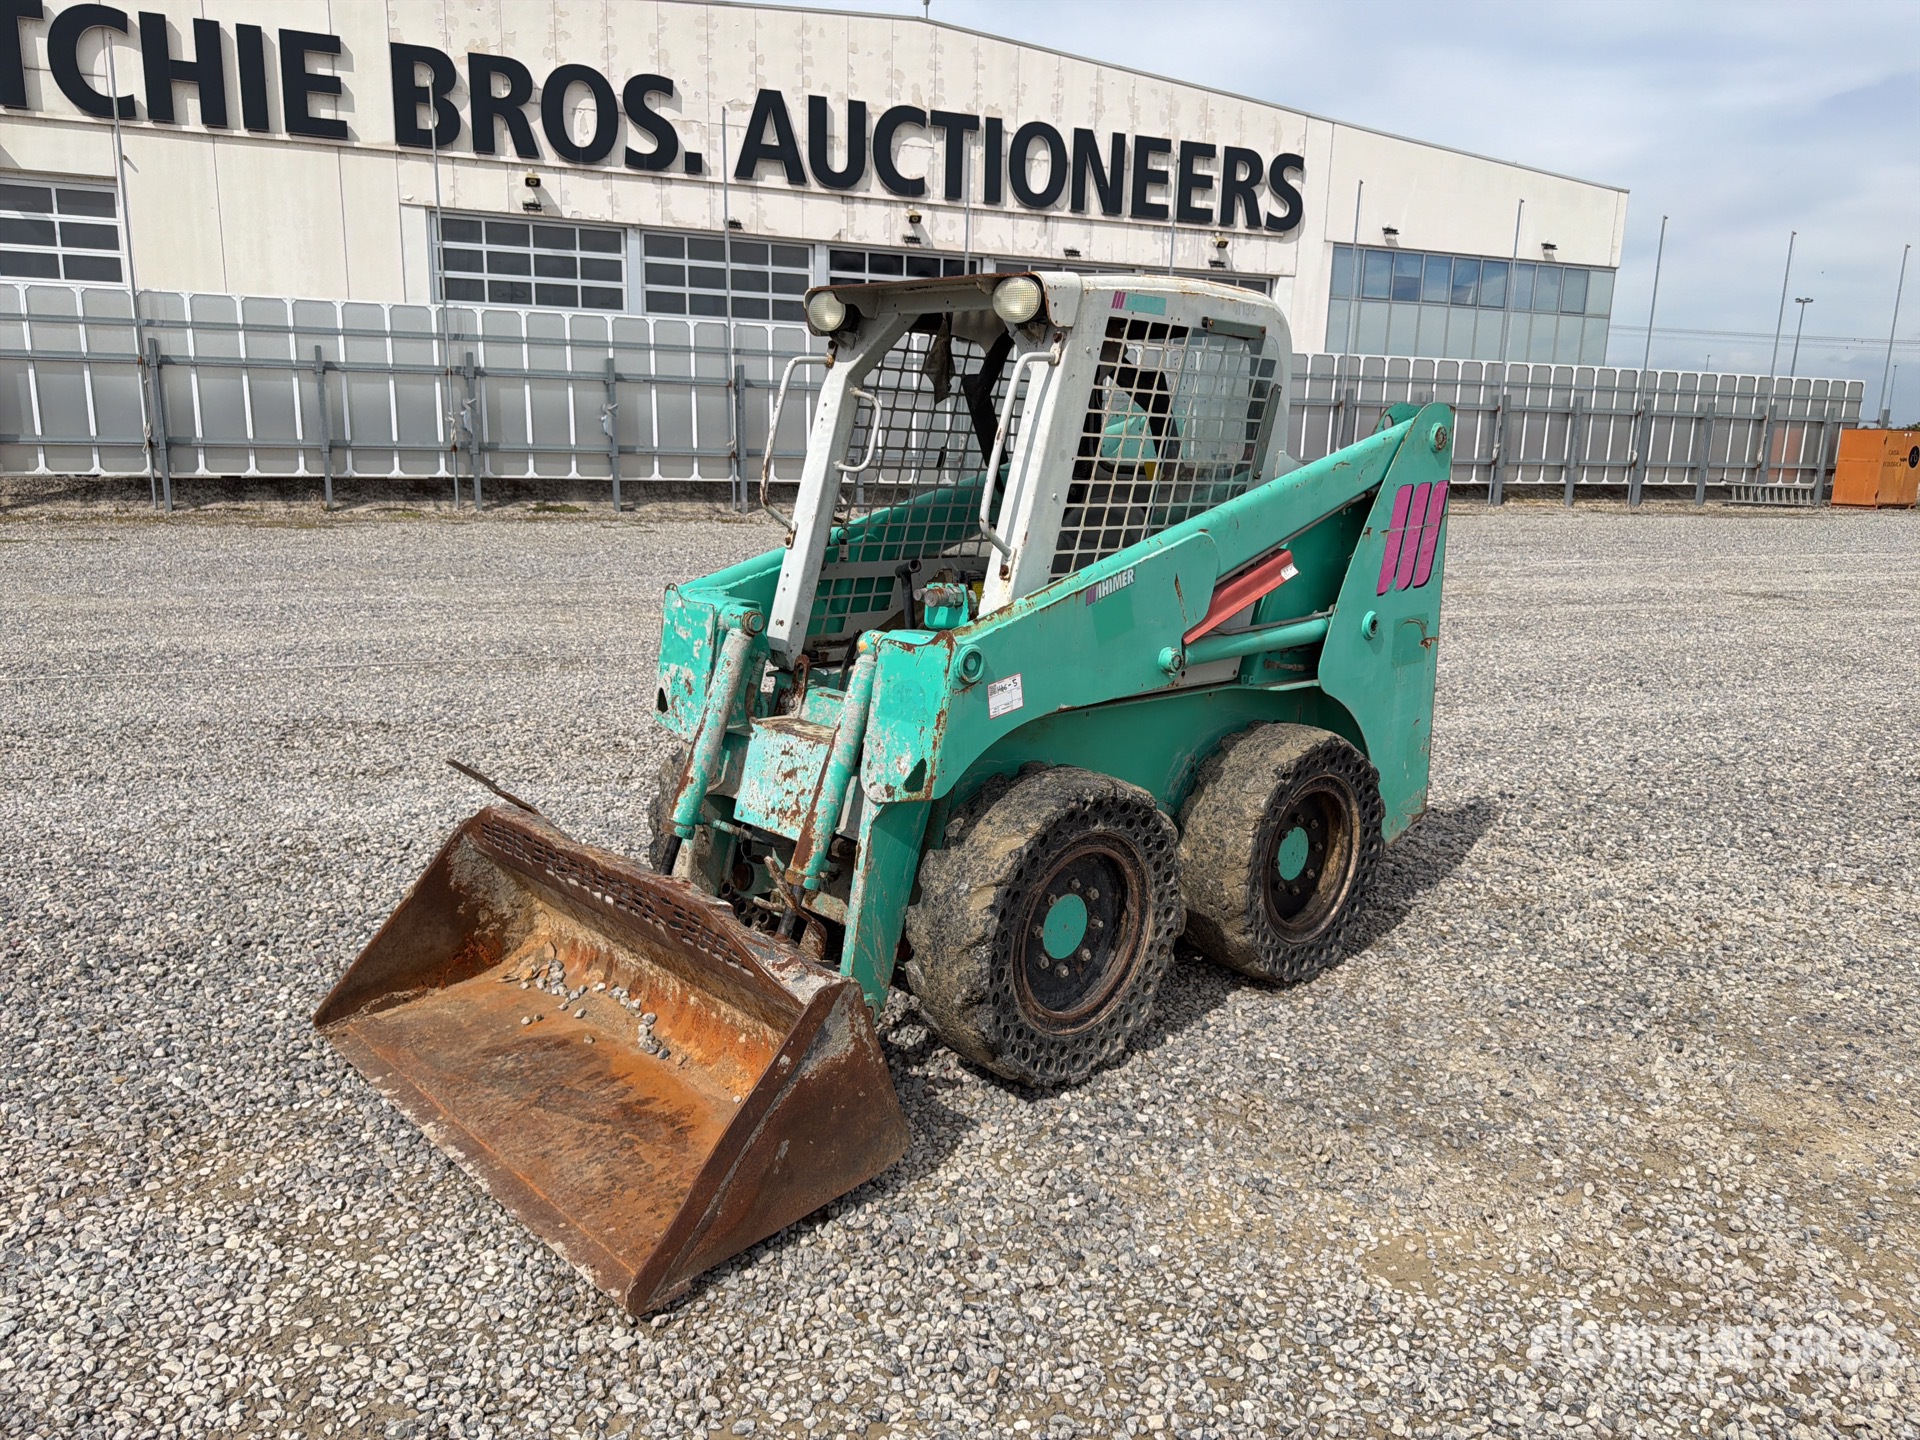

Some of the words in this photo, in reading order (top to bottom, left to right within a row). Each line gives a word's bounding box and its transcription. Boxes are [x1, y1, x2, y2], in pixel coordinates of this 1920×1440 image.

[0, 0, 348, 139] TCHIE
[390, 42, 703, 174] BROS.
[734, 88, 1306, 231] AUCTIONEERS
